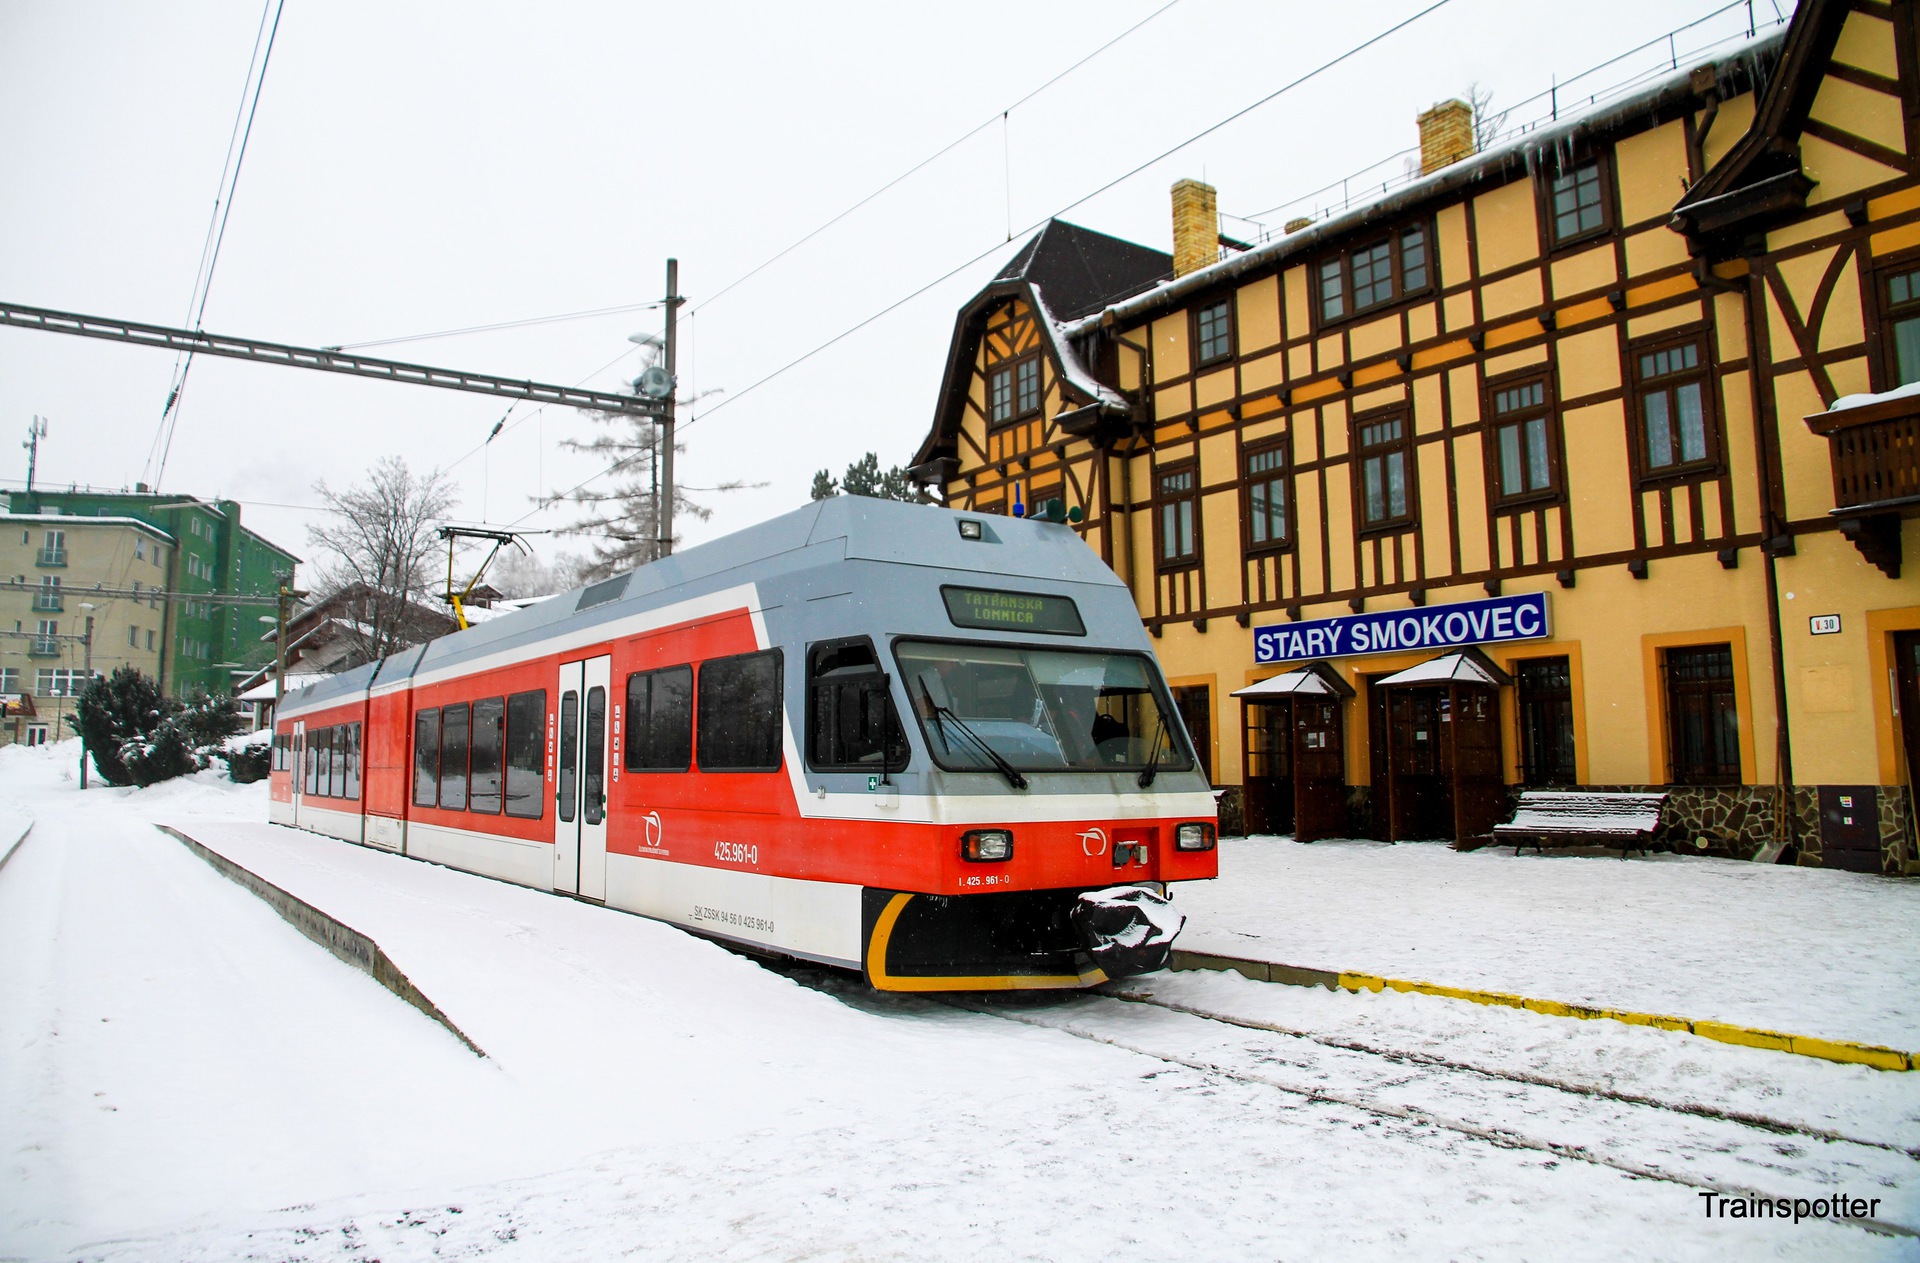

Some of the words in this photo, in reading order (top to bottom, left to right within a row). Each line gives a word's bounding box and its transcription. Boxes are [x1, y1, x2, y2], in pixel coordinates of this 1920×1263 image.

[974, 608, 1034, 623] LOMNICA
[1823, 619, 1834, 630] 30
[1257, 620, 1343, 660] STARÝ
[1351, 603, 1539, 651] SMOKOVEC
[714, 840, 758, 865] 425.961-0
[694, 905, 703, 918] SK
[703, 907, 720, 922] ZSSK
[720, 911, 729, 924] 94
[729, 913, 738, 926] 56
[737, 914, 743, 927] 0
[743, 916, 755, 930] 425
[755, 918, 775, 934] 961-0
